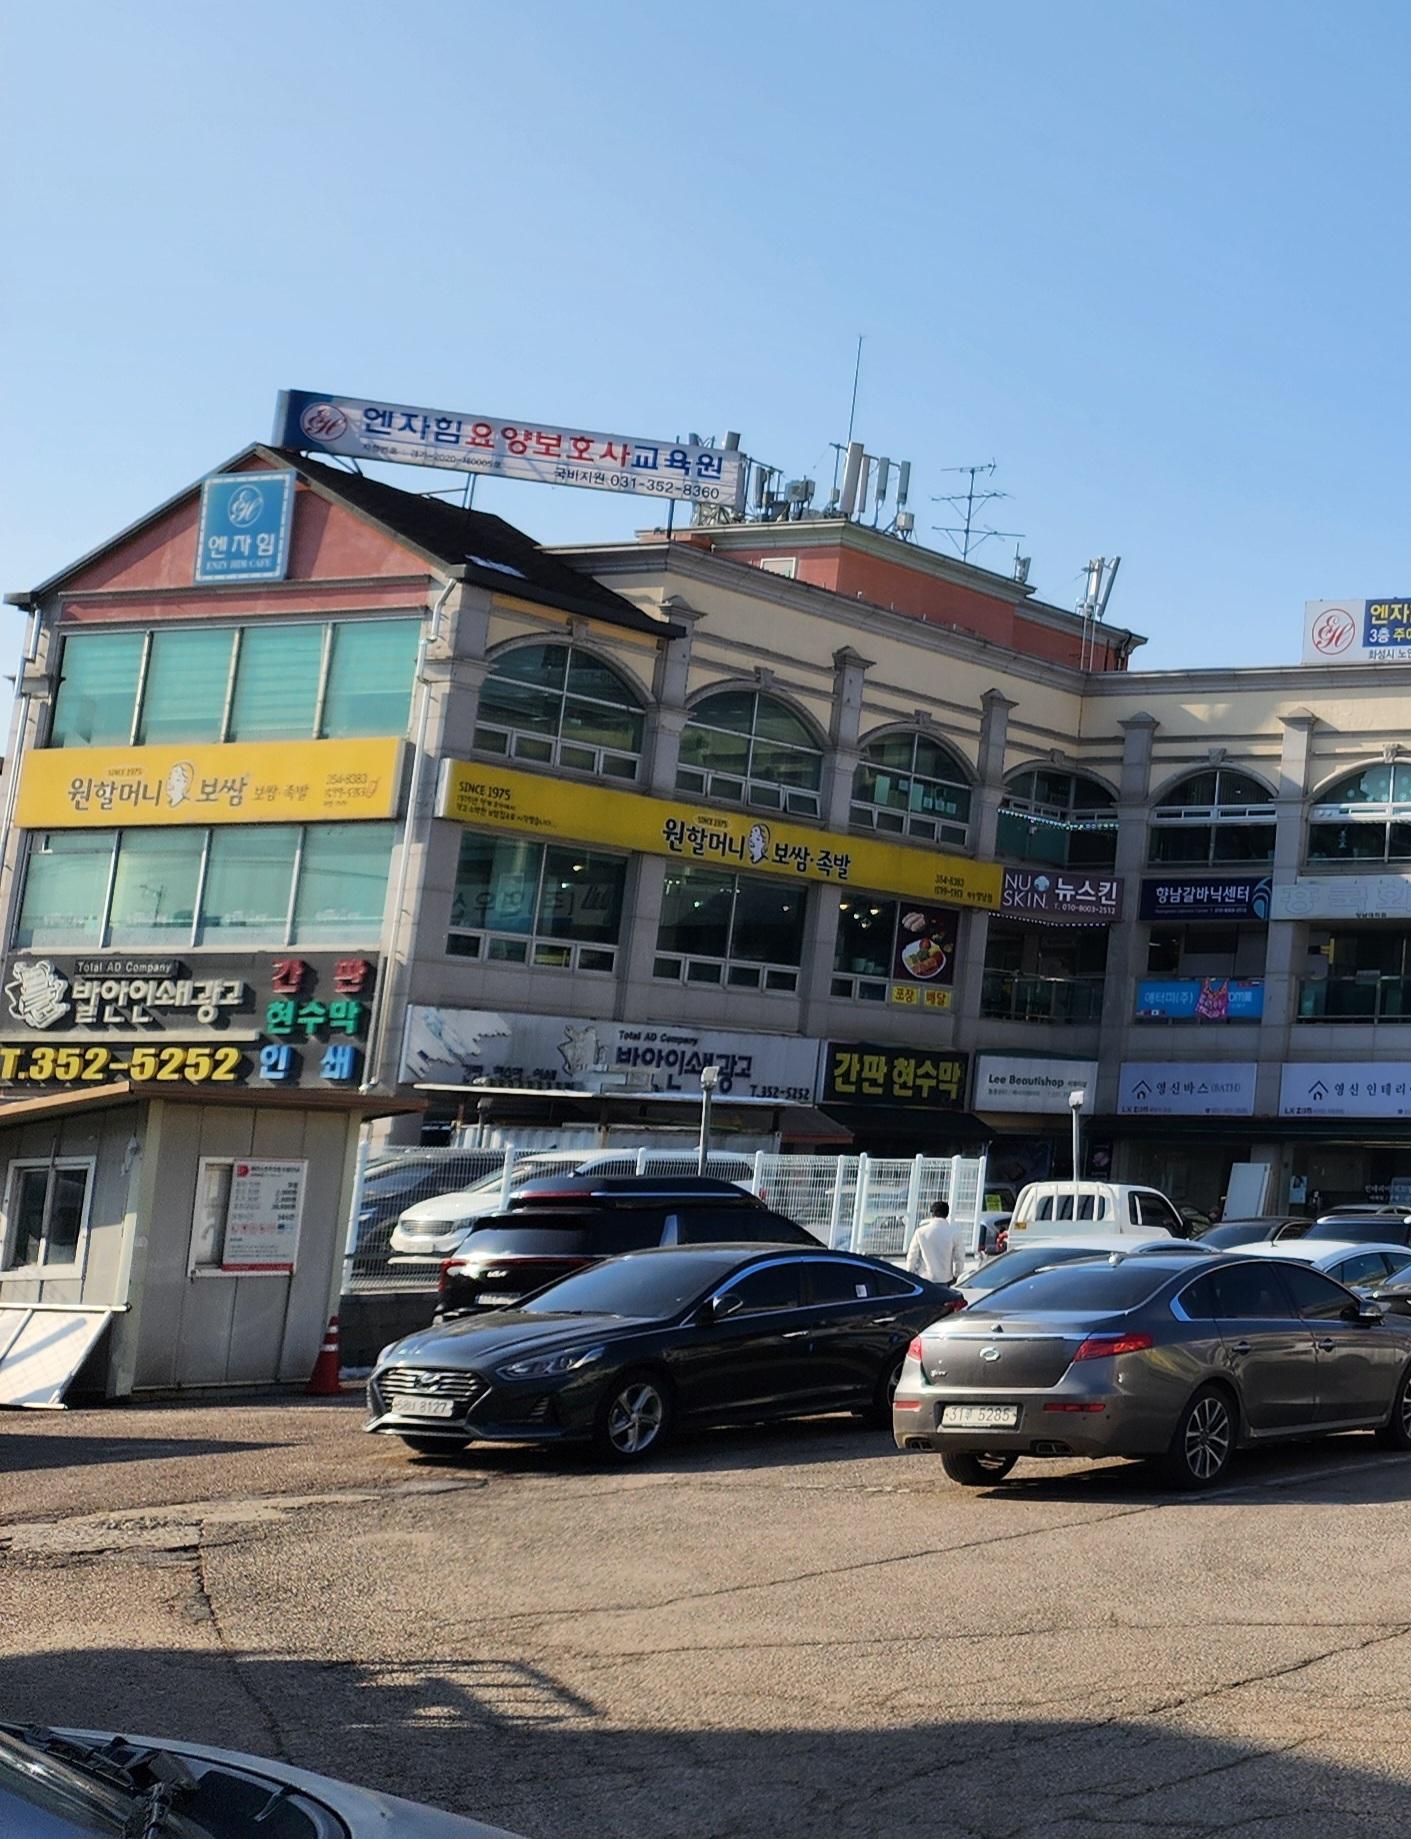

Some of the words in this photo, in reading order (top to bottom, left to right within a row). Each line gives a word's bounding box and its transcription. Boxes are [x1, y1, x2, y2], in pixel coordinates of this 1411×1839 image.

[363, 407, 723, 479] 엔자힘요양보호사교육원
[554, 466, 606, 485] 국비지원
[610, 475, 720, 499] 031-352-8360
[208, 533, 276, 558] 엔자힘
[1369, 627, 1391, 643] 3층
[68, 778, 163, 811] 원할머니
[195, 777, 247, 807] 보쌈
[459, 780, 485, 796] SINCE
[488, 786, 511, 800] 1975
[663, 818, 746, 861] 원할머니
[1004, 873, 1031, 890] NU
[1055, 878, 1117, 905] 뉴스킨
[1002, 890, 1046, 909] SKIN
[1156, 886, 1250, 904] 향남갈바닉센터
[77, 961, 103, 973] Total
[106, 961, 122, 973] AD
[125, 962, 172, 975] Company
[72, 979, 244, 1024] 발안인쇄광고
[266, 1000, 363, 1035] 현수막
[619, 1030, 641, 1041] Total
[644, 1033, 657, 1042] AD
[660, 1034, 699, 1046] Company
[0, 1047, 240, 1081] T.352-5252
[260, 1044, 357, 1081] 인쇄
[833, 1052, 887, 1094] 간판
[892, 1056, 961, 1100] 현수막
[988, 1074, 1006, 1085] Lee
[1333, 1082, 1360, 1097] 영신
[978, 1408, 1010, 1422] 5285
